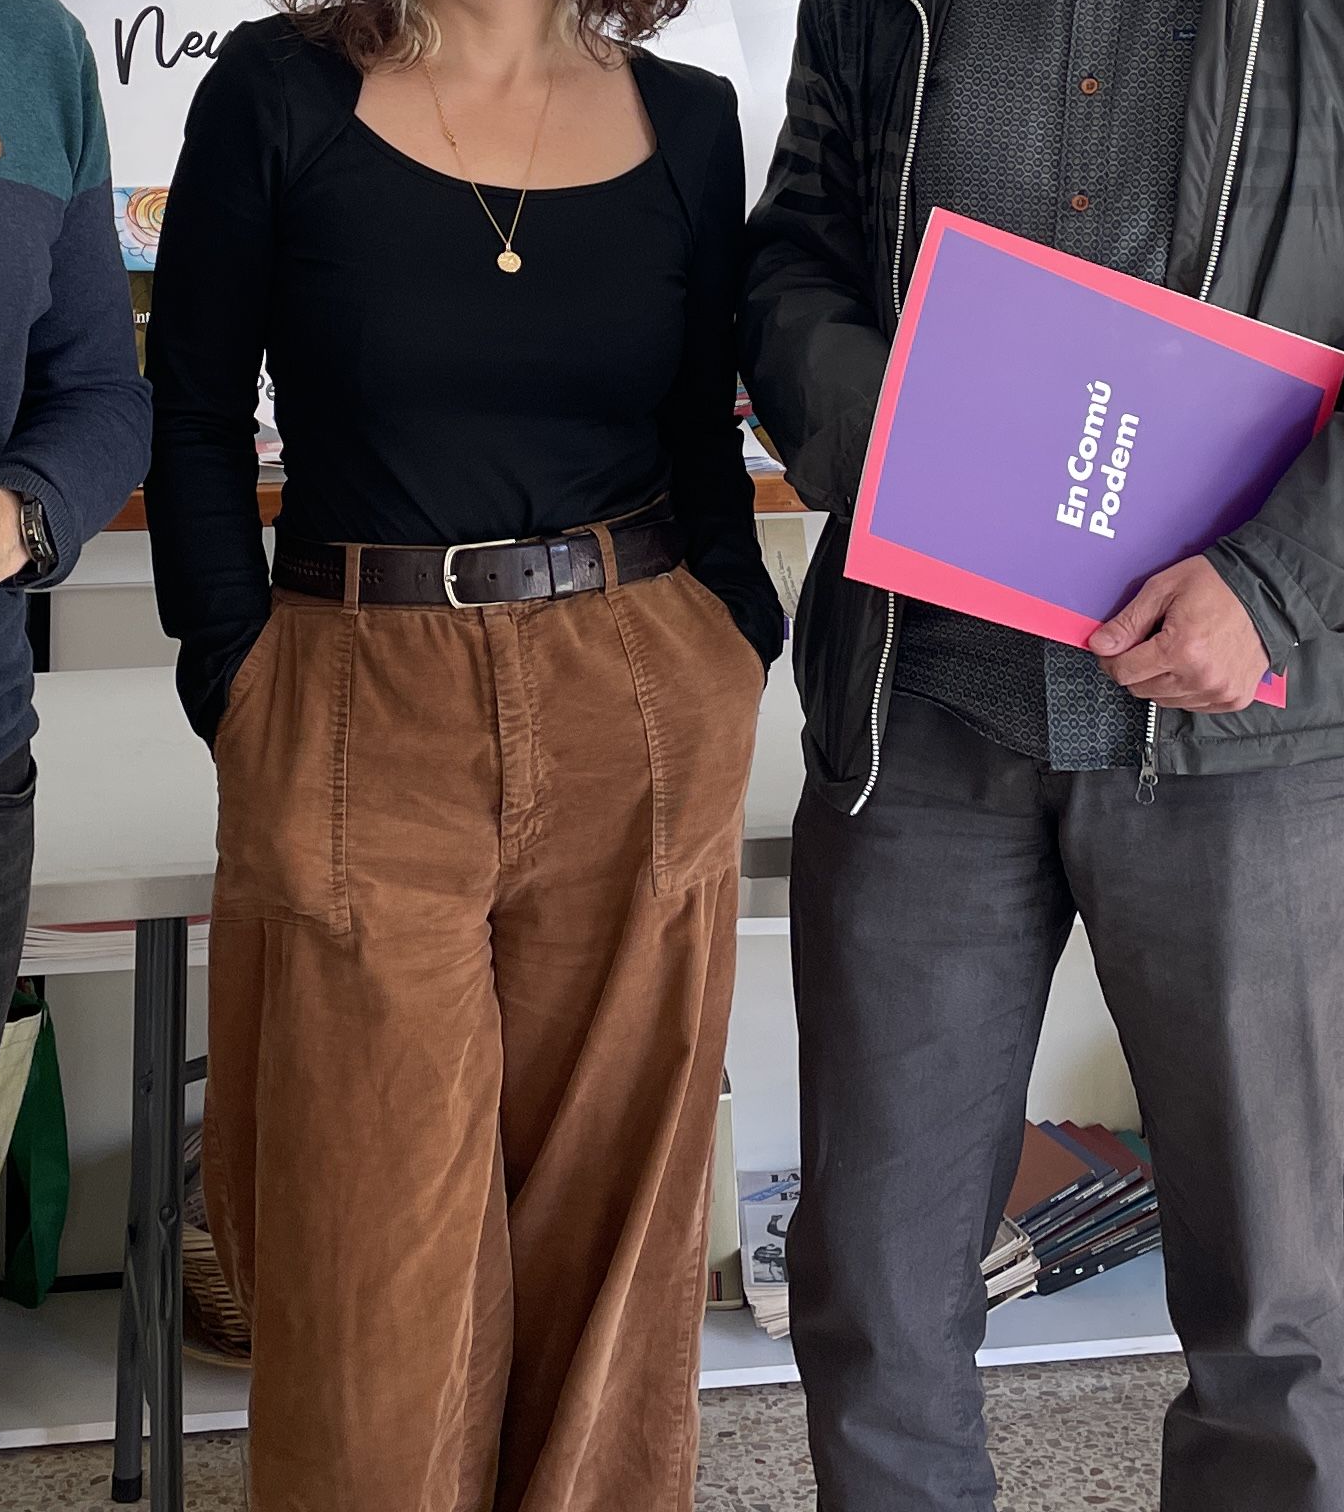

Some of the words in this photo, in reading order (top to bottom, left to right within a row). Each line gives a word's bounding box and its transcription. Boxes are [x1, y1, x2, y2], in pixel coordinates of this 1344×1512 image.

[1067, 380, 1112, 482] Comú
[1088, 412, 1141, 540] Podem
[1055, 484, 1090, 529] En
